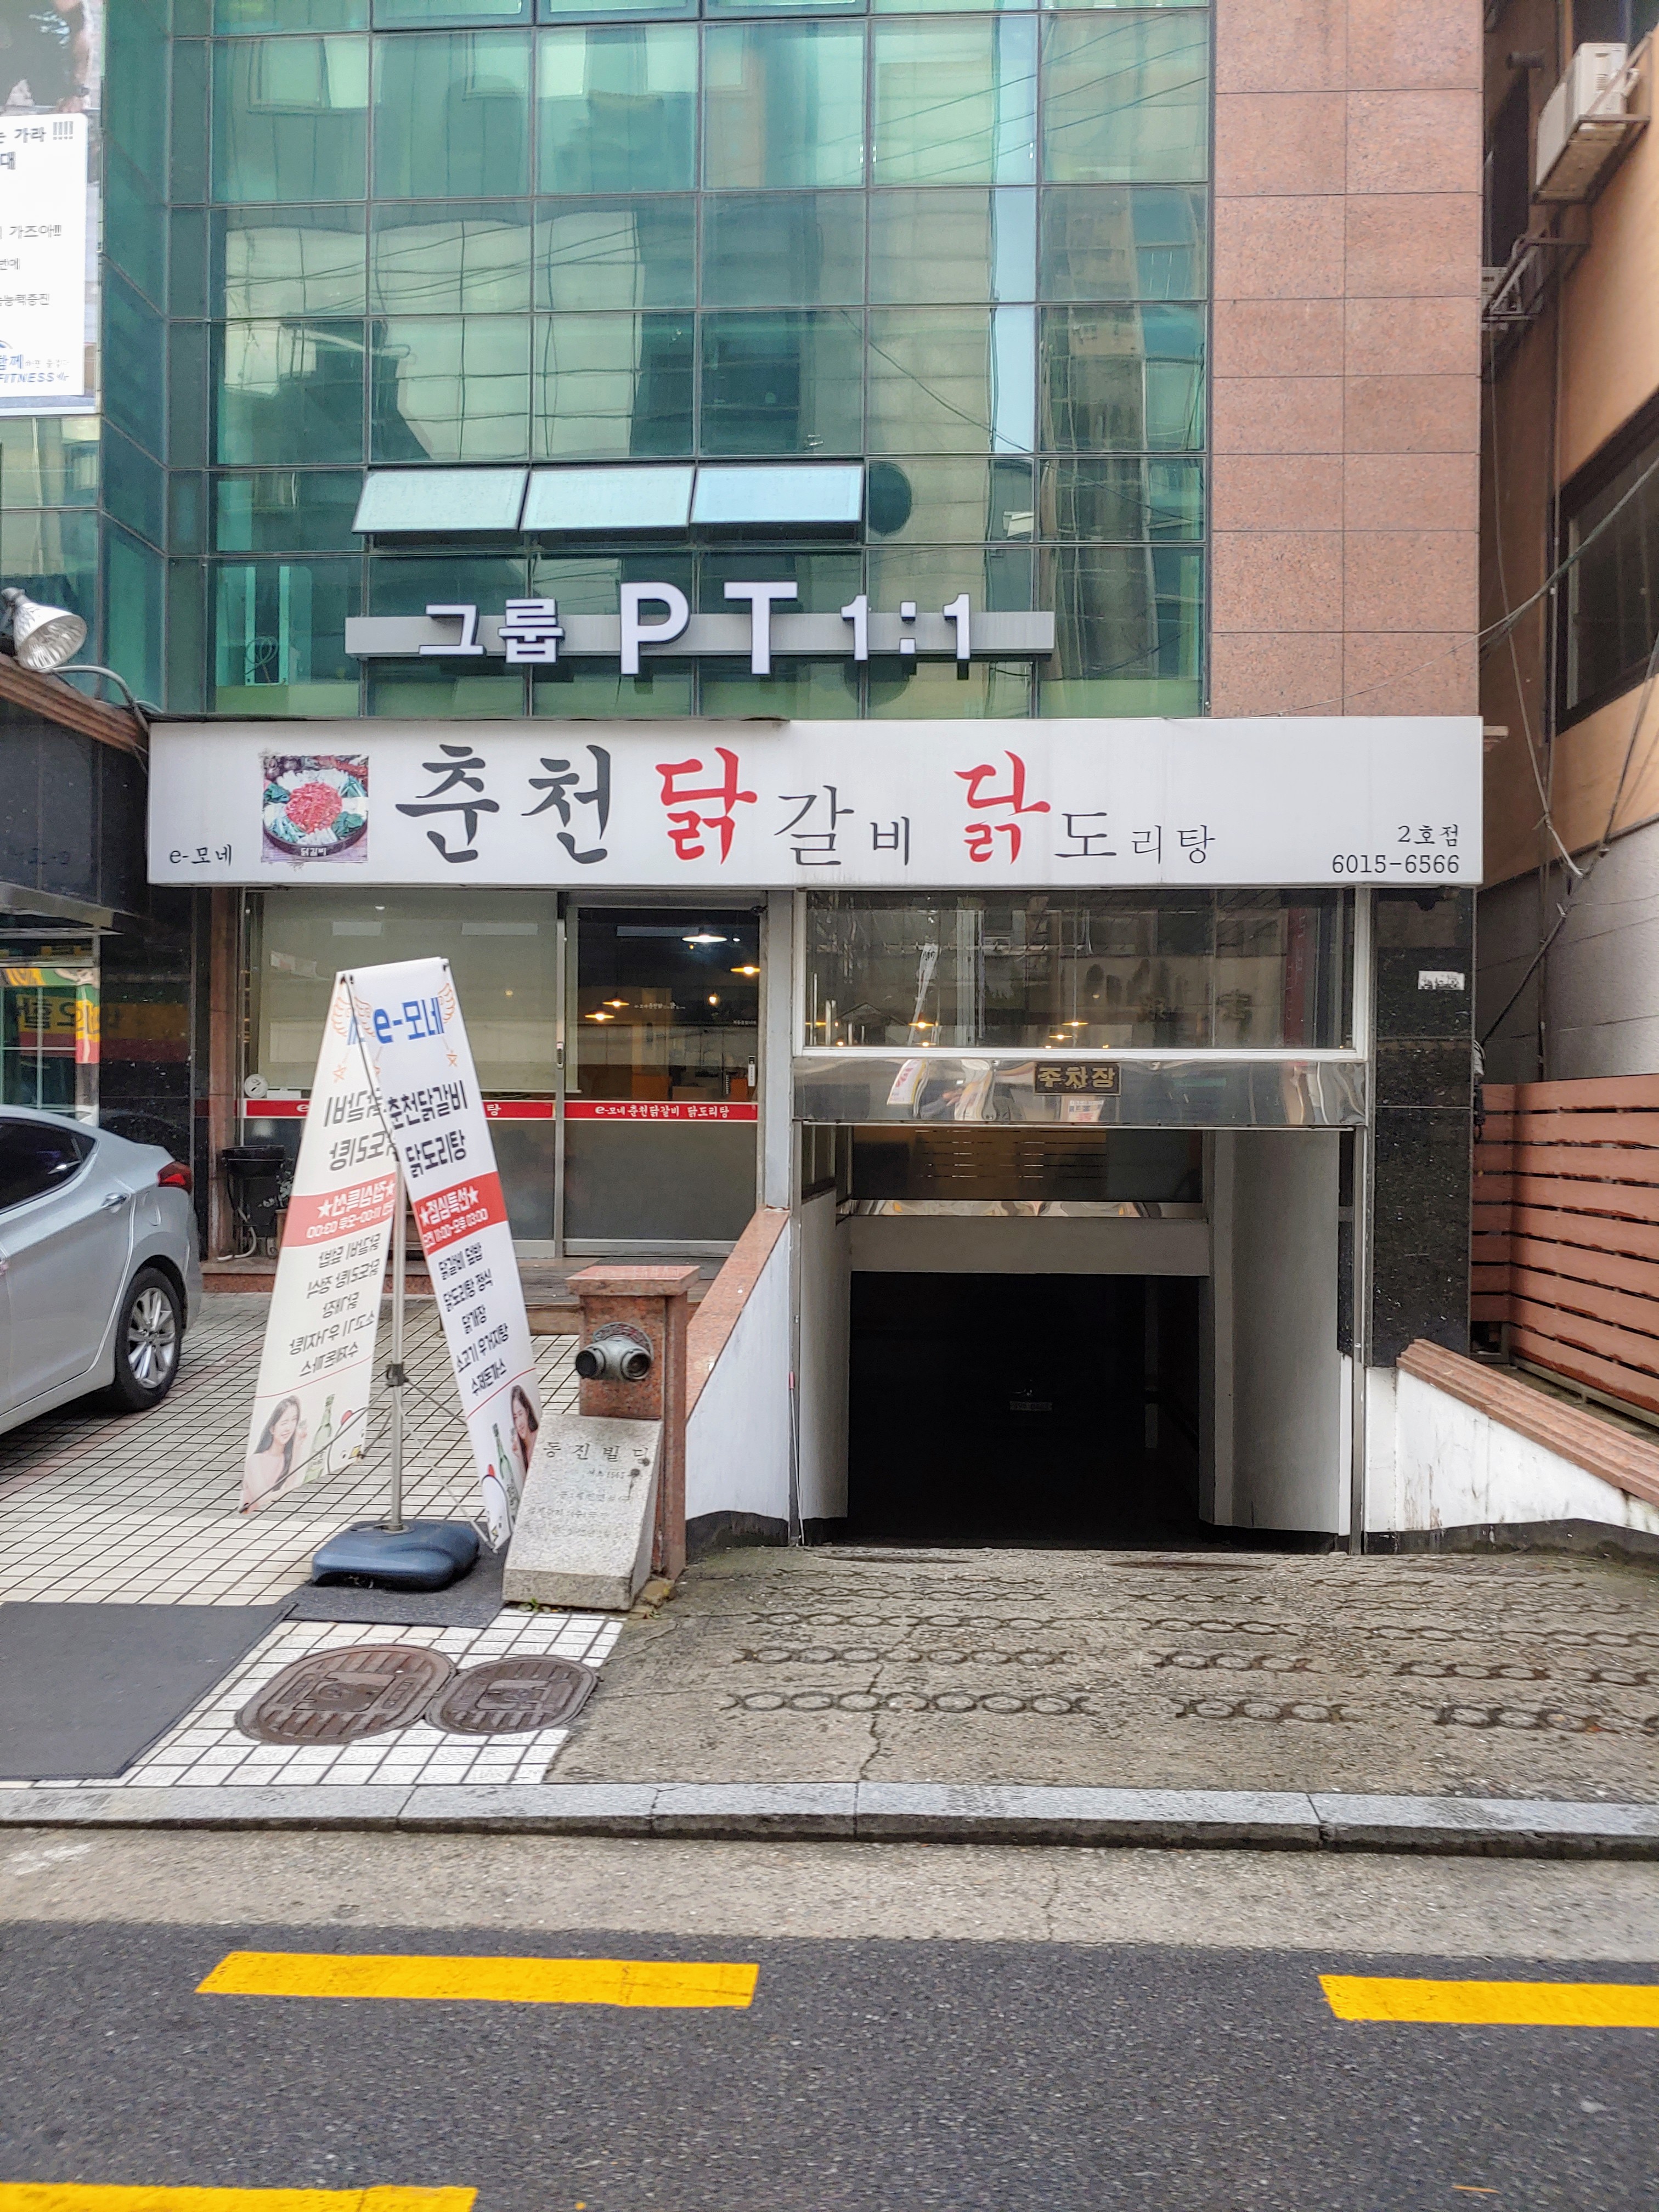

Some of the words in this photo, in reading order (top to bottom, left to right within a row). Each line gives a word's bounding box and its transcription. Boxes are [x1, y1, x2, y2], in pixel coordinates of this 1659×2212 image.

[417, 597, 565, 663] 그룹
[620, 581, 799, 675] PT
[840, 592, 972, 662] 1:1
[395, 744, 612, 865] 춘천
[955, 750, 1216, 865] 닭도리탕
[1398, 823, 1459, 848] 2호점
[169, 843, 232, 866] e-모네
[1332, 854, 1460, 873] 6015-6566
[373, 997, 445, 1044] e-모네
[1037, 1066, 1116, 1089] 주차장
[387, 1080, 469, 1130] 춘천닭갈비
[595, 1106, 625, 1115] e-모네
[628, 1104, 679, 1118] 춘천닭갈비
[687, 1105, 730, 1118] 닭도리탕
[405, 1128, 467, 1178] 닭도리탕
[443, 1278, 476, 1312] 닭도리탕
[456, 1342, 479, 1373] 소고기
